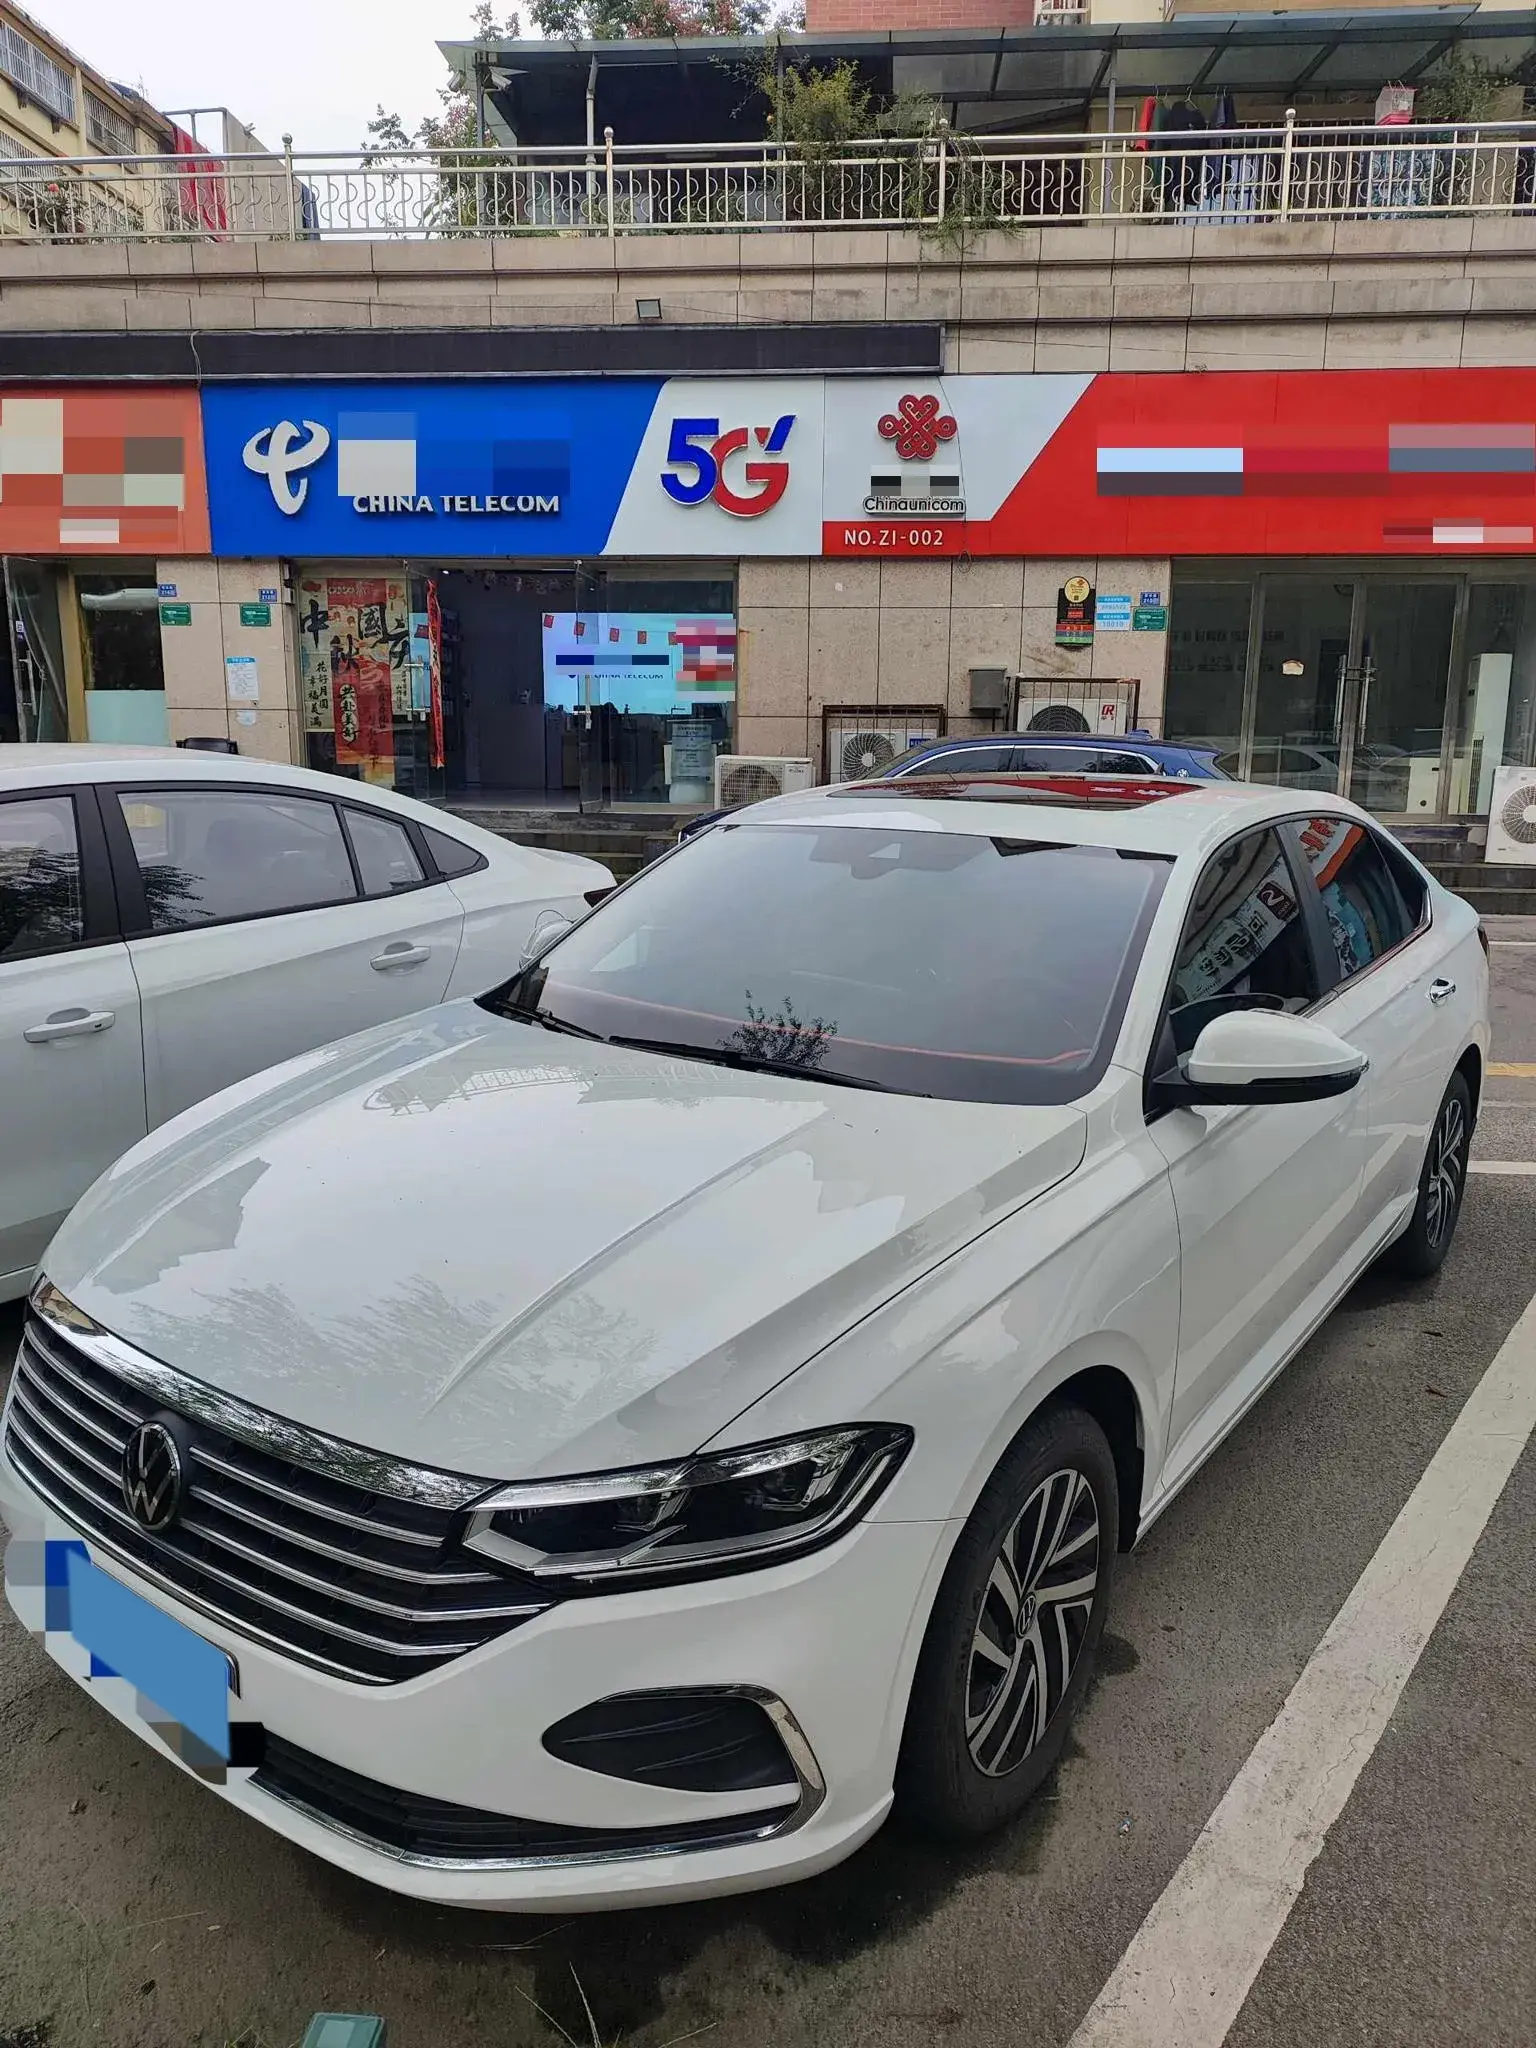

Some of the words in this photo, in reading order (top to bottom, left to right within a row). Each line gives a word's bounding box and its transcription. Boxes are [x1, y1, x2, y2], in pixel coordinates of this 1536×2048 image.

[660, 415, 797, 517] 5G
[352, 495, 434, 513] CHINA
[440, 495, 560, 513] TELECOM
[864, 496, 964, 511] Chinaunicom
[844, 529, 943, 546] NO.ZI-002
